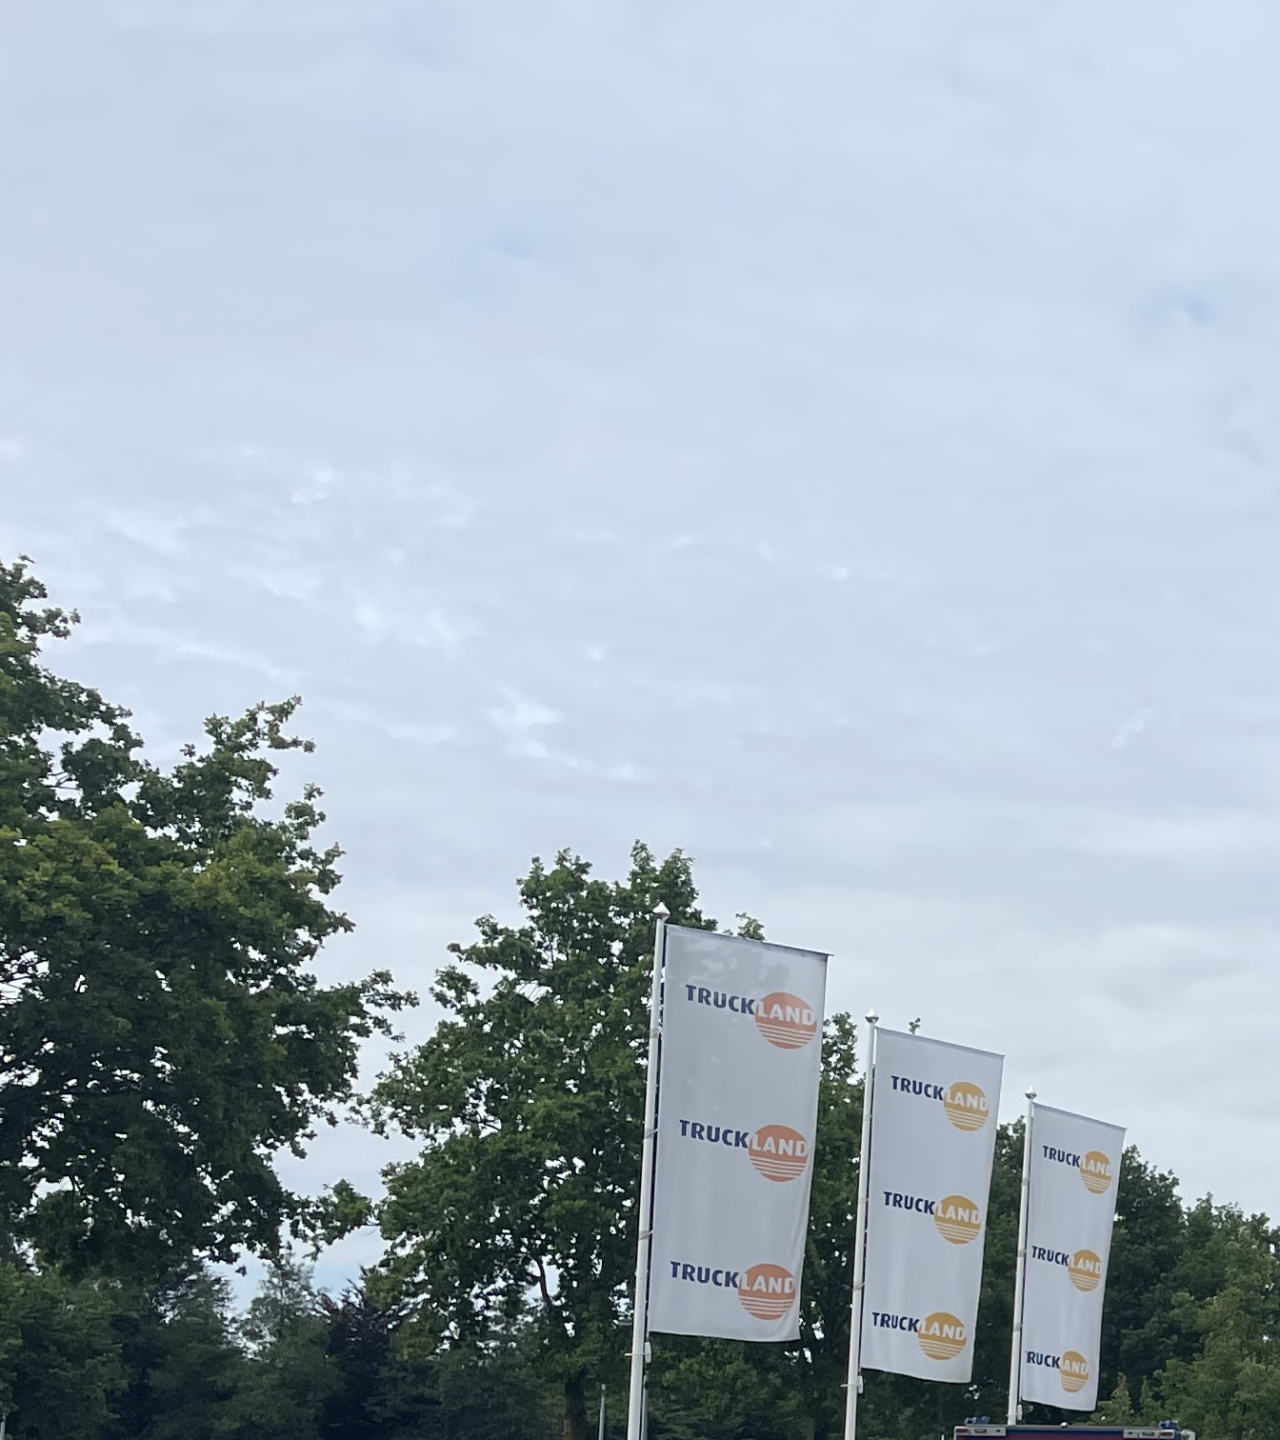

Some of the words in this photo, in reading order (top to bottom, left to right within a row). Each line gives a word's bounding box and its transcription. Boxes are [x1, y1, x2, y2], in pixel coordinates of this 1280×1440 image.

[685, 984, 816, 1026] TRUCKLAND
[891, 1075, 989, 1112] TRUCKLAND
[679, 1119, 808, 1158] TRUCKLAND
[883, 1191, 980, 1225] TRUCKLAND
[670, 1261, 796, 1294] TRUCKLAND
[872, 1312, 966, 1341] TRUCKLAND
